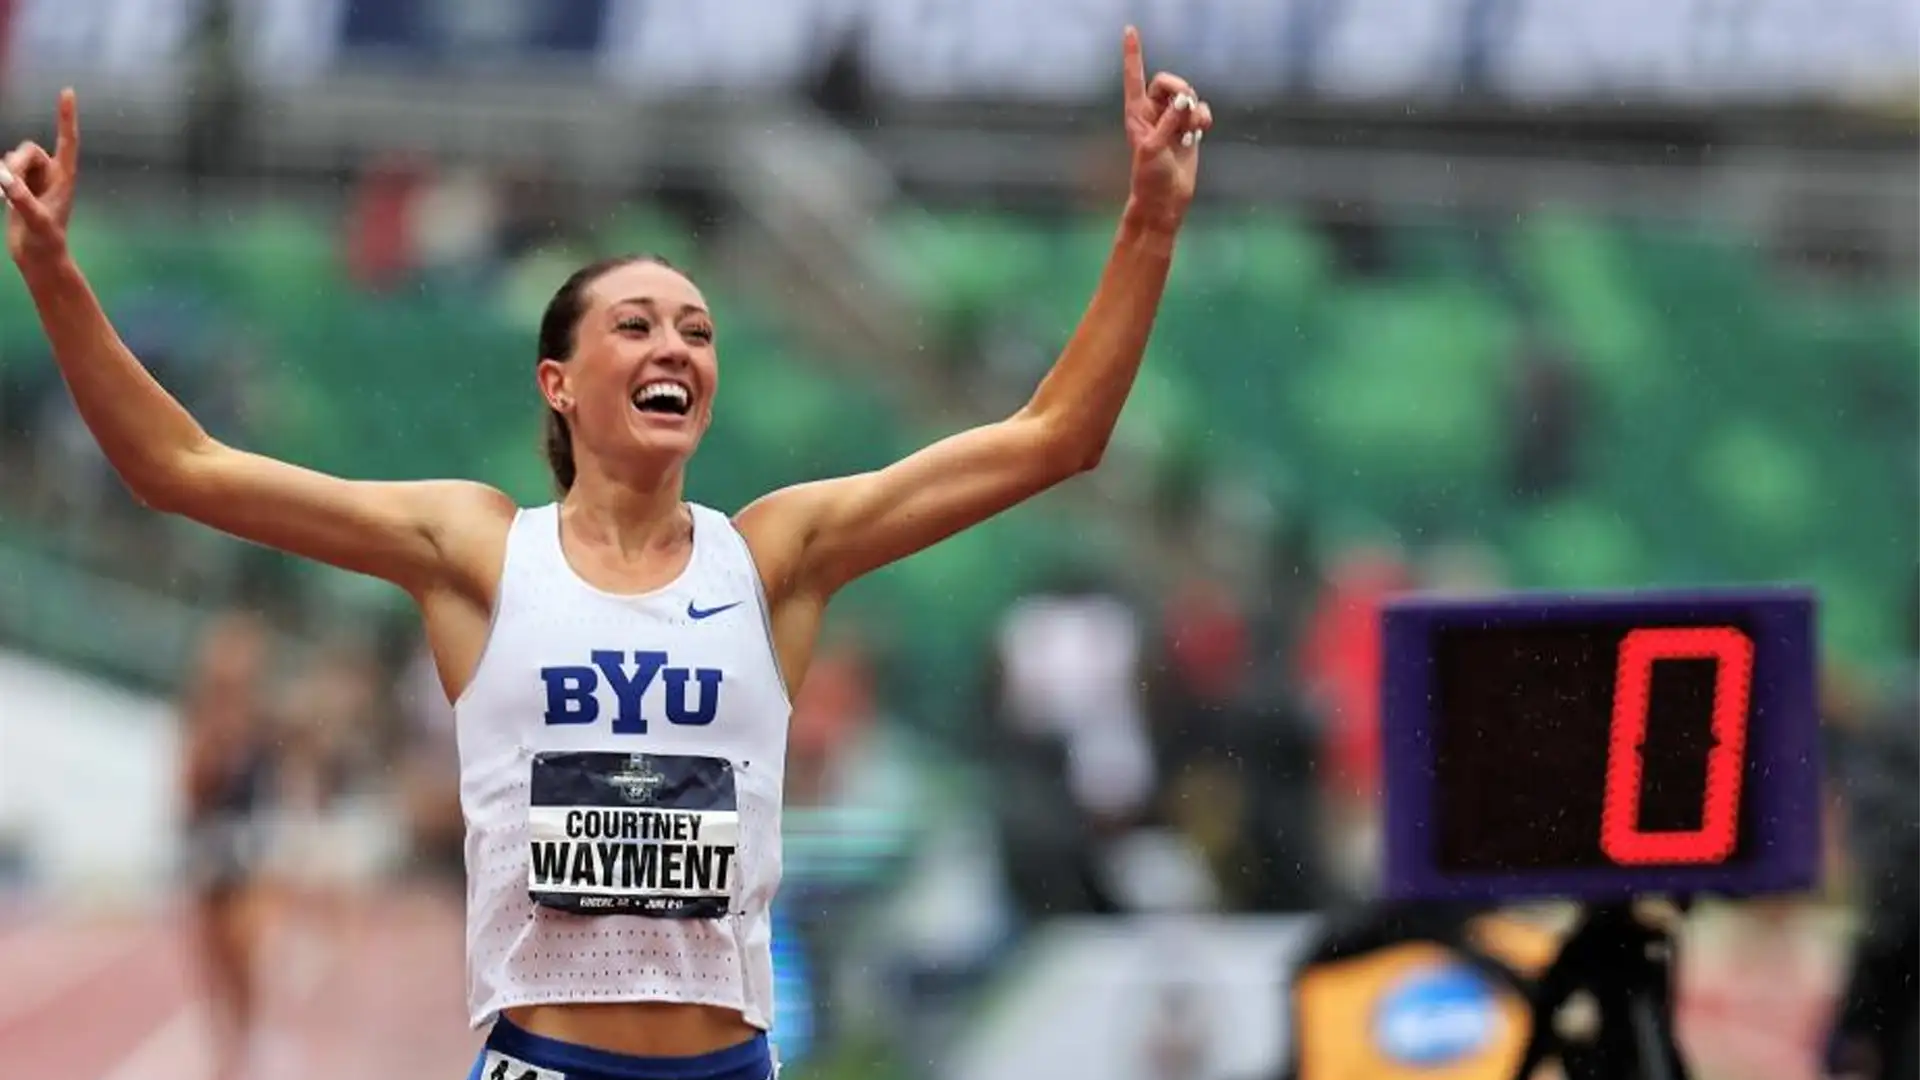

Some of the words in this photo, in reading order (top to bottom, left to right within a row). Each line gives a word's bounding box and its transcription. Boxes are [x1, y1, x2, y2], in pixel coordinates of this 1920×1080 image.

[541, 649, 723, 734] BYU
[1600, 627, 1755, 867] 0
[566, 810, 702, 841] COURTNEY
[531, 842, 735, 889] WAYMENT
